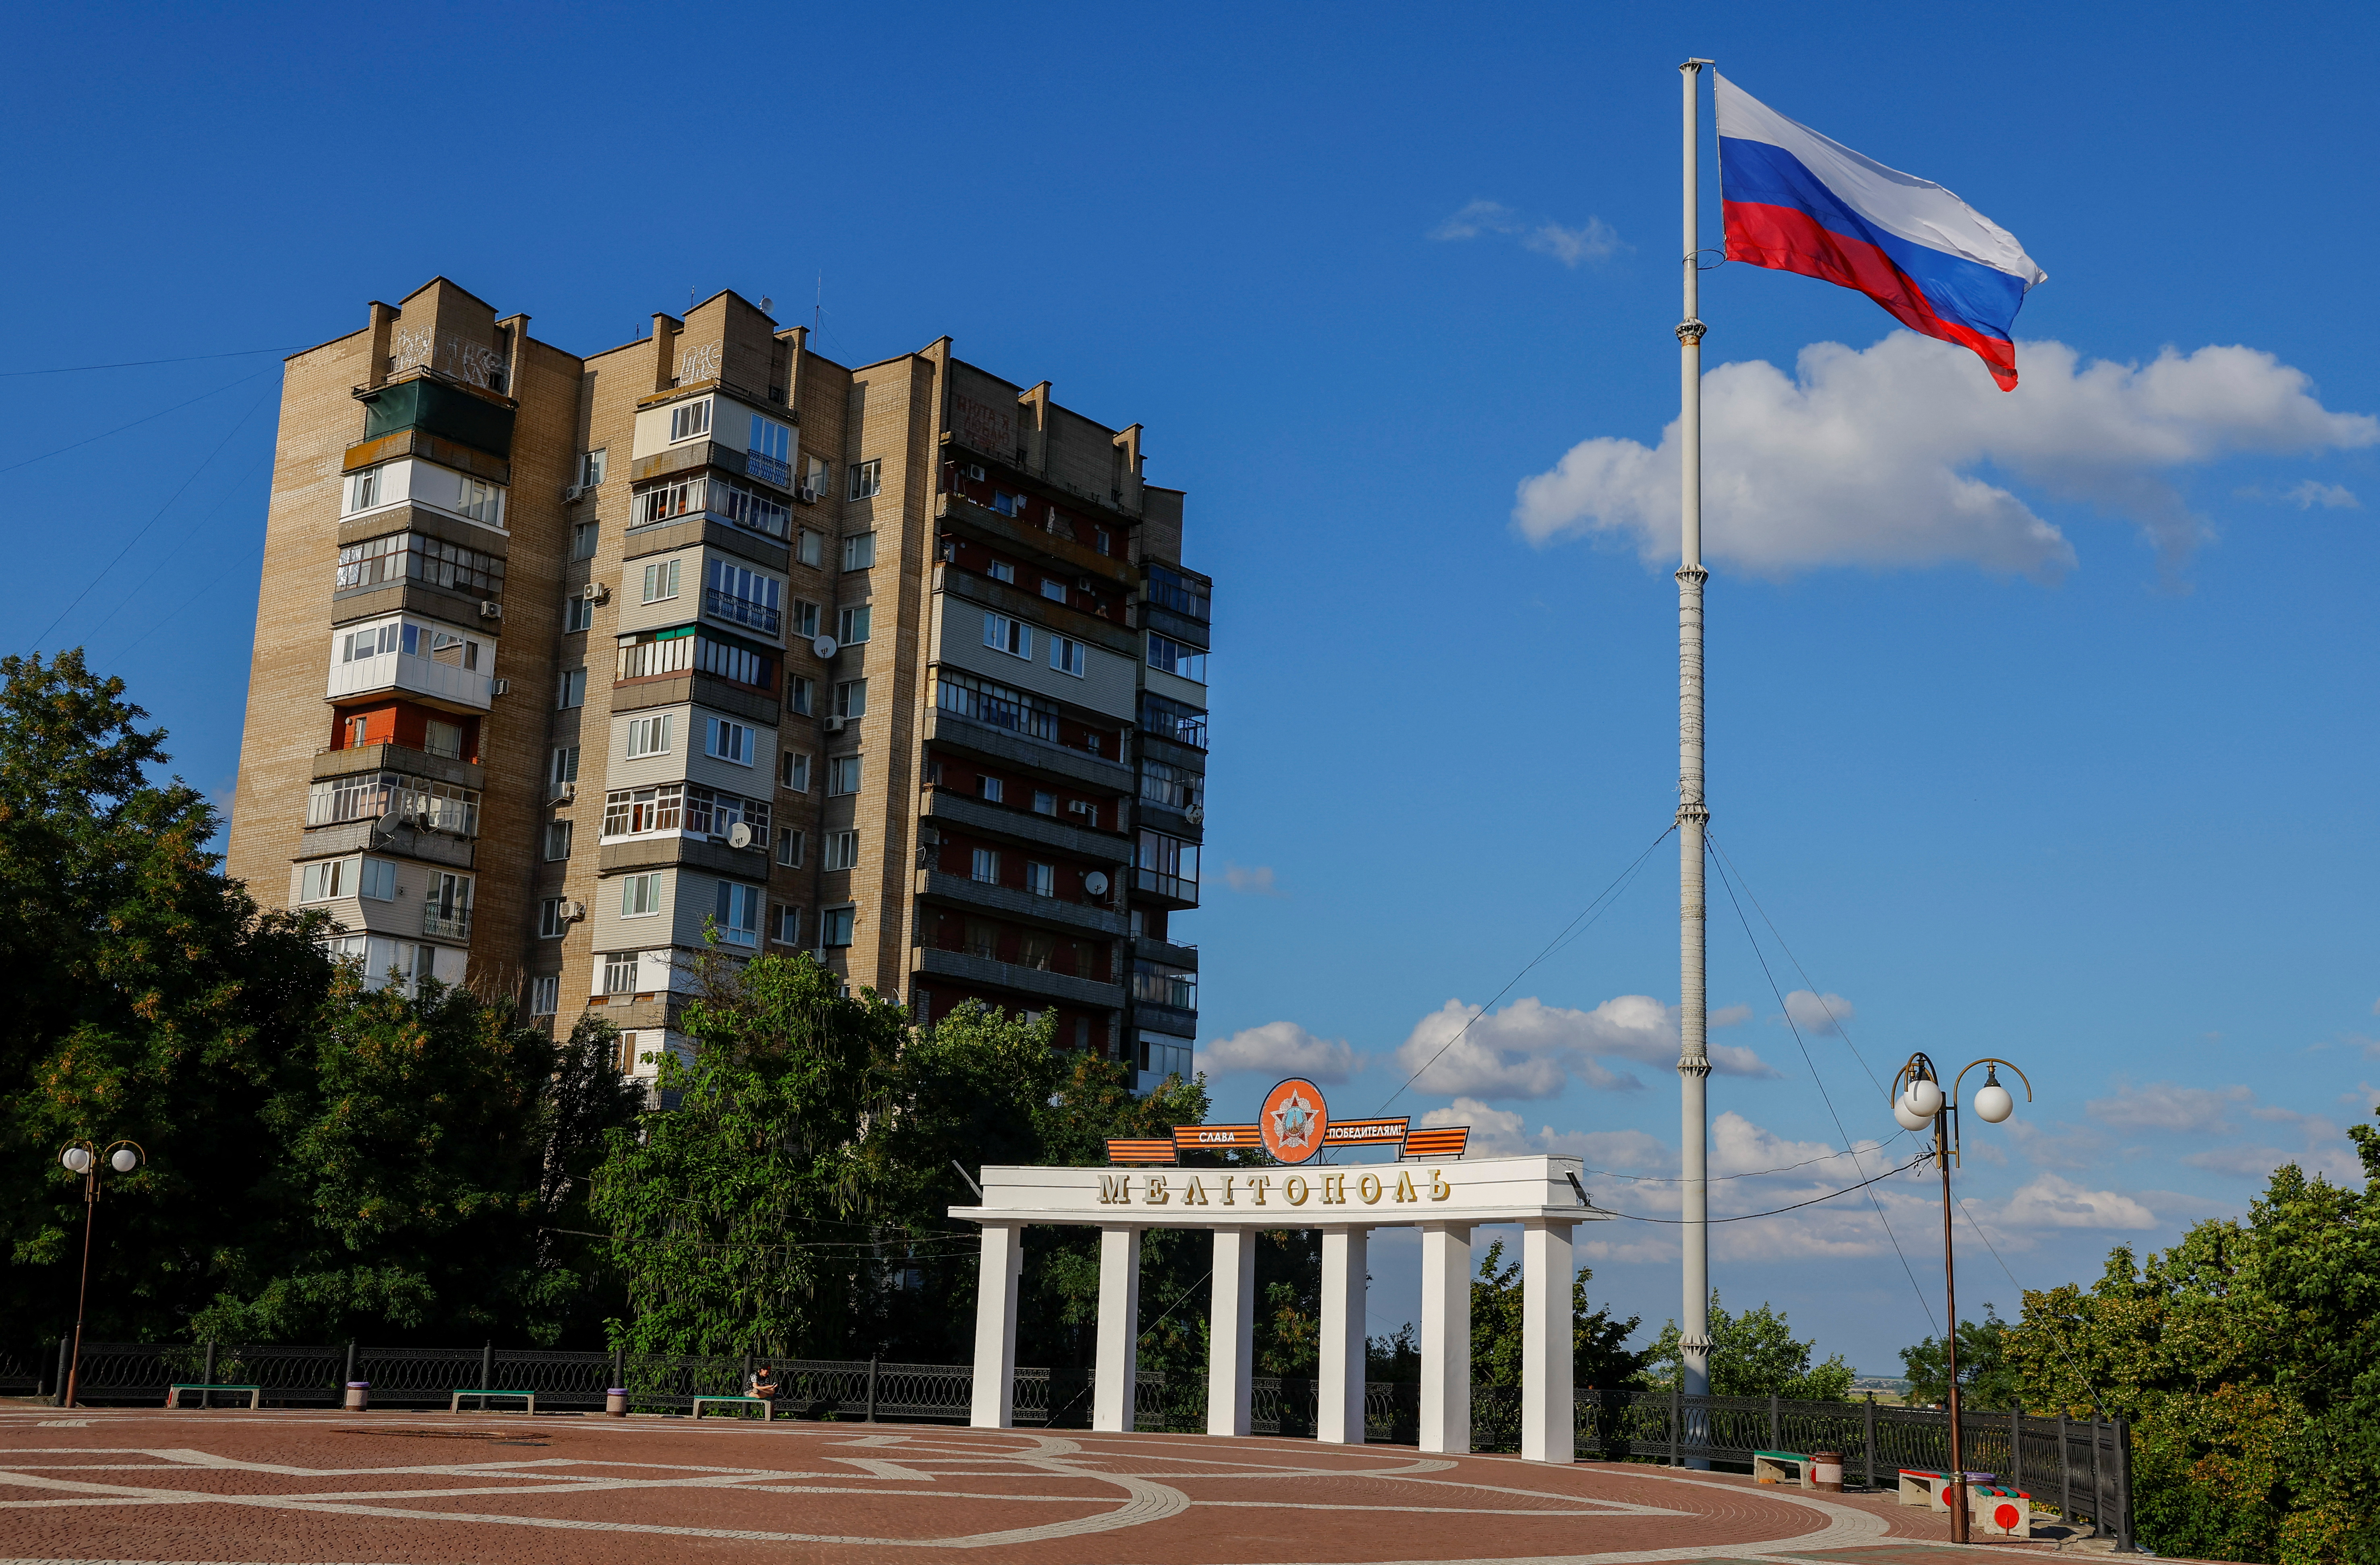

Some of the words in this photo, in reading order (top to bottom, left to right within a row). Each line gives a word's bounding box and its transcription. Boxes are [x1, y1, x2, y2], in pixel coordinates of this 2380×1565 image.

[1199, 1132, 1235, 1142] СЛАВА
[1329, 1125, 1401, 1139] ПОБЕДИТЕЛЯМ!
[1096, 1169, 1450, 1206] МЕЛІТОПОЛЬ
